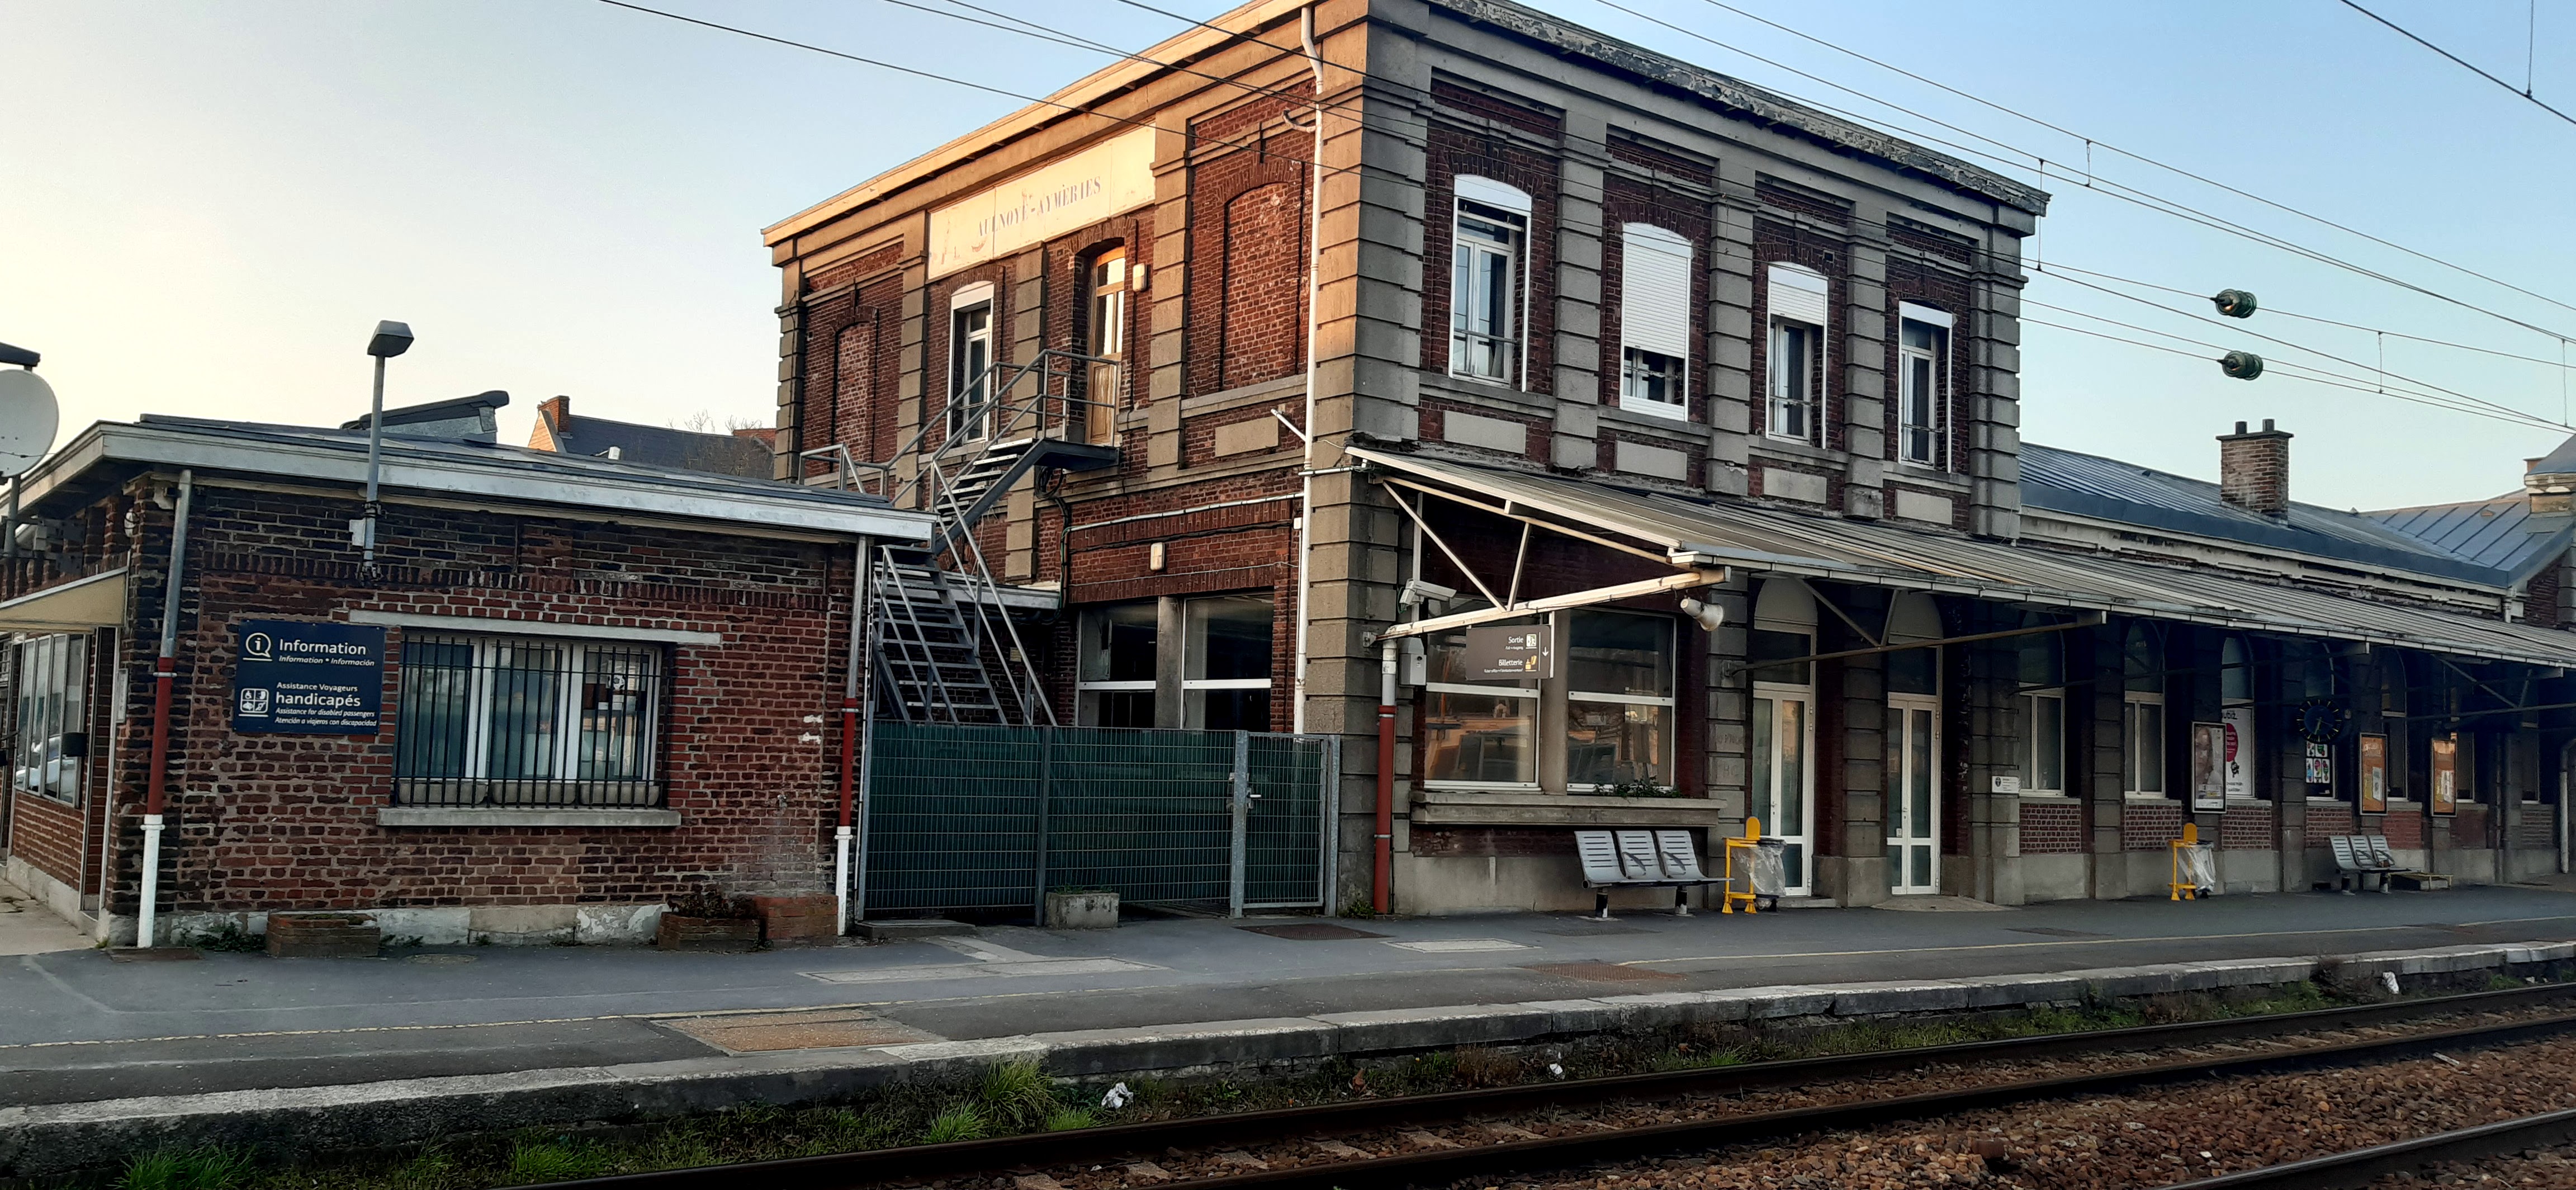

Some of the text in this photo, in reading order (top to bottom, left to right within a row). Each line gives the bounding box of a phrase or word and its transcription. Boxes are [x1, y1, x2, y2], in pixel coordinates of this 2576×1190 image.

[280, 639, 366, 655] Information
[278, 655, 375, 666] Information Información
[277, 682, 358, 692] Assistance Voyageurs
[276, 691, 361, 709] handicapés
